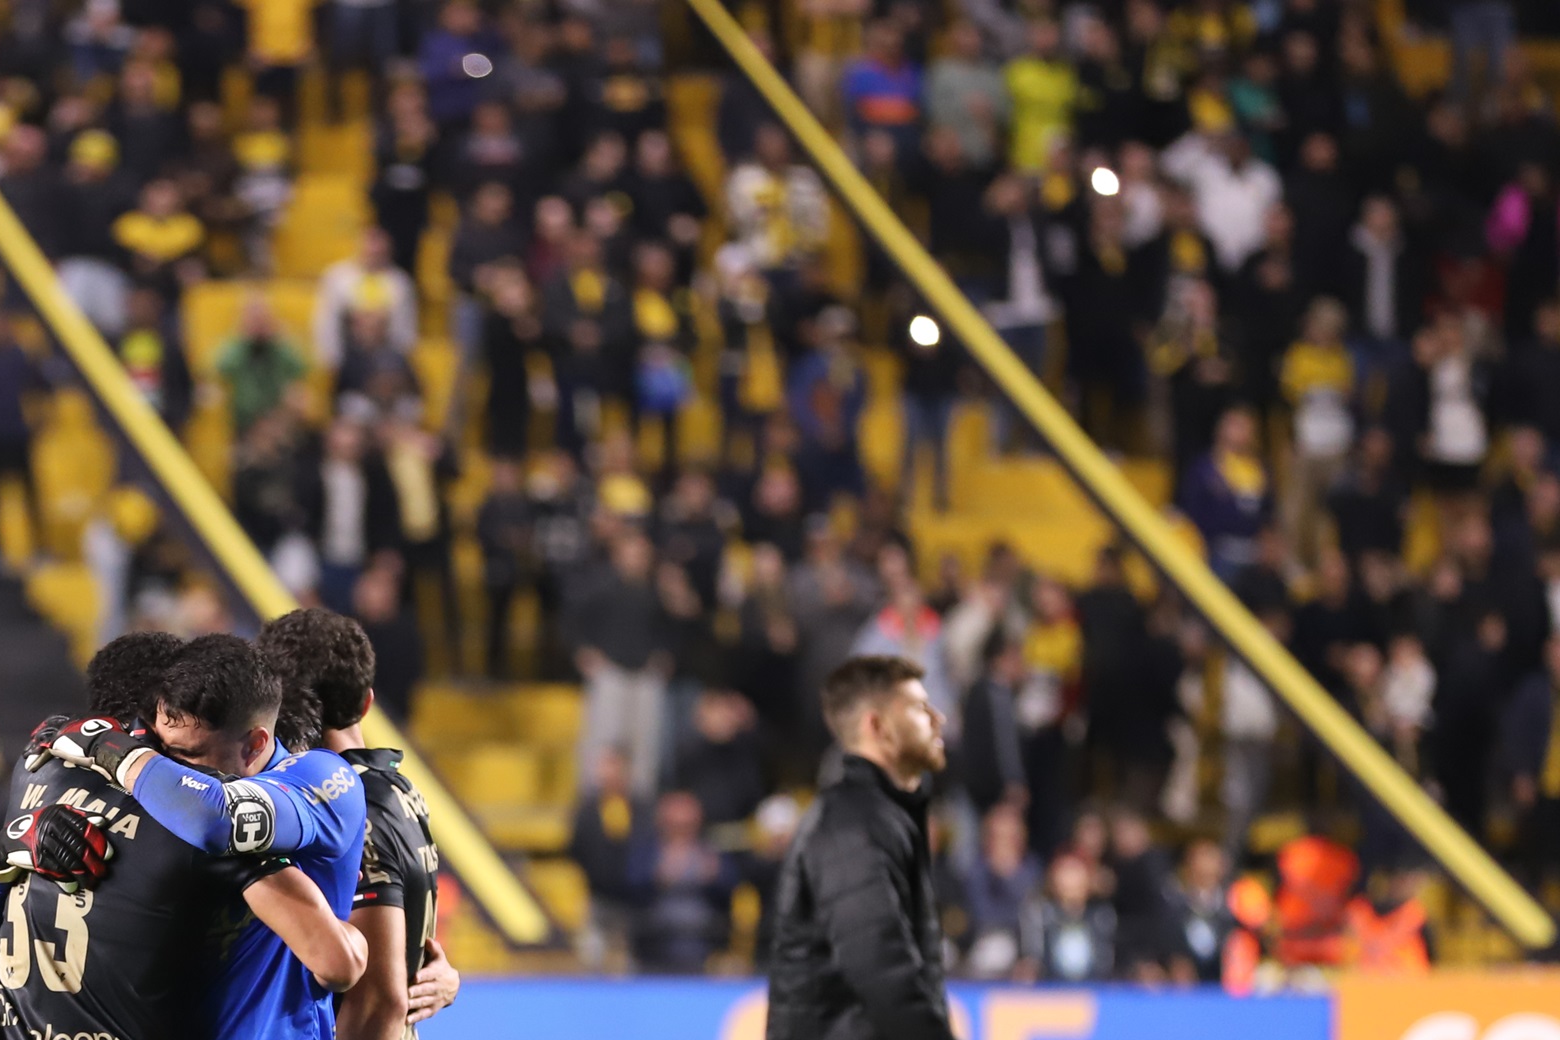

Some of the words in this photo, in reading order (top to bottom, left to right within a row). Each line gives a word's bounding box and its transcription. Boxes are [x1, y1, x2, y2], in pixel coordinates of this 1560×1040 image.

[180, 774, 210, 792] VOLT
[20, 783, 48, 810] W.
[55, 787, 140, 840] MAIA
[242, 813, 262, 822] VOLT
